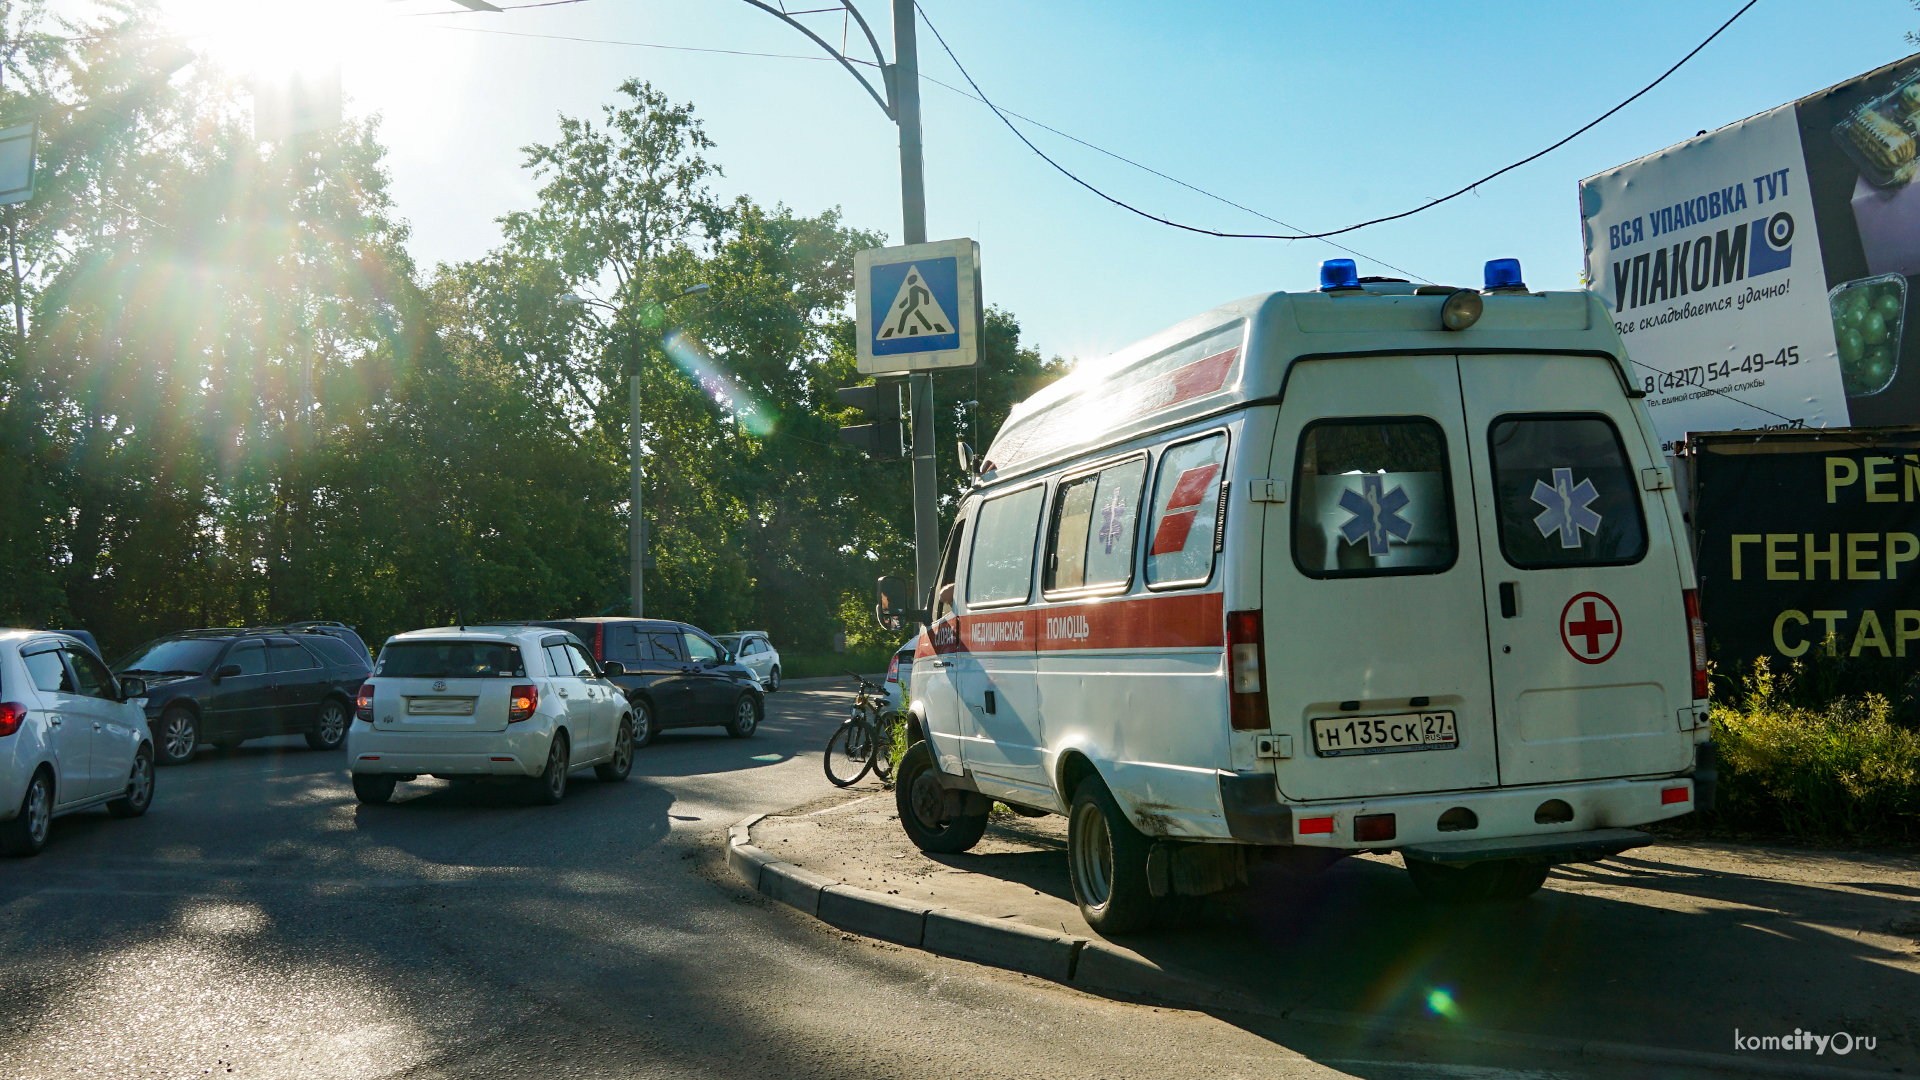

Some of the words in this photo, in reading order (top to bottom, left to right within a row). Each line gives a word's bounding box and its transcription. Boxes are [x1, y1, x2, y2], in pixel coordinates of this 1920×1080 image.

[1609, 216, 1644, 250] ВСЯ
[1649, 182, 1748, 237] УПАКОВКА
[1753, 167, 1790, 204] ТУТ
[1613, 222, 1749, 313] УПАКОМ
[1614, 321, 1635, 335] Все
[1639, 296, 1732, 331] складывается
[1737, 279, 1790, 310] удачно!
[1644, 375, 1655, 394] 8
[1658, 366, 1705, 394] (4217)
[1707, 345, 1799, 381] 54-49-45
[1661, 393, 1688, 405] единой
[1688, 384, 1733, 402] справочной
[1733, 378, 1766, 392] службы
[1731, 532, 1920, 581] ГЕНЕР
[971, 620, 1024, 646] МЕДИЦИНСКАЯ
[1046, 615, 1090, 642] ПОМОЩЬ
[1423, 716, 1445, 734] 27
